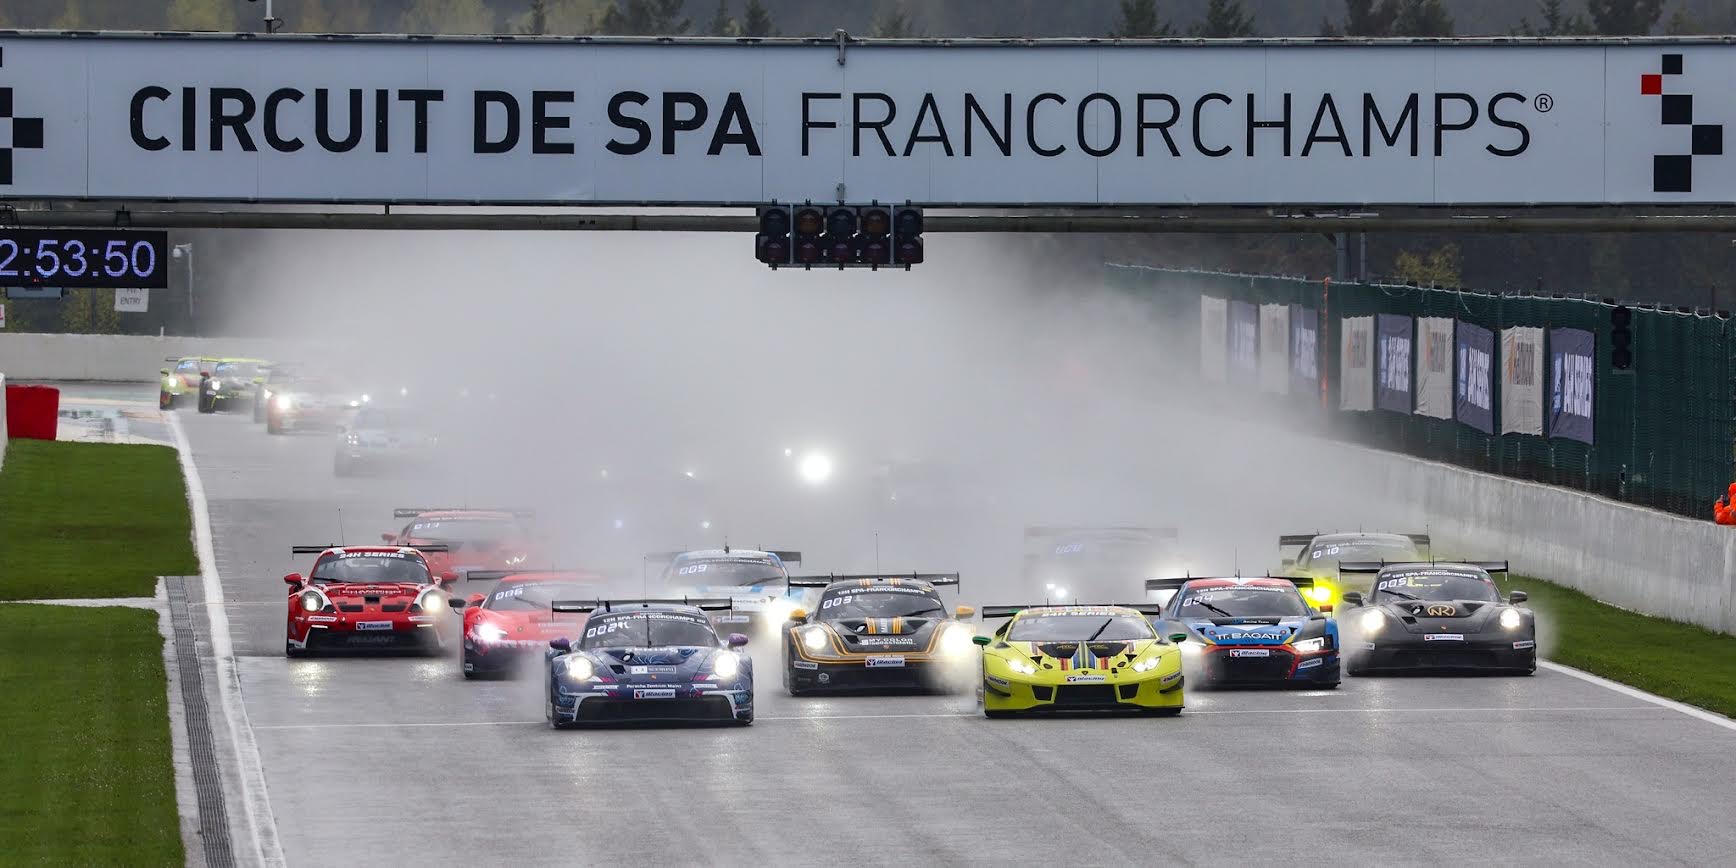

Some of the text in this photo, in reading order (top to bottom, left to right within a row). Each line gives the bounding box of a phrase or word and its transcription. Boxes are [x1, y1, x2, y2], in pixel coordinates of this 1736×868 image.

[129, 85, 444, 154] CIRCUIT
[473, 90, 575, 155] DE
[604, 90, 762, 157] SPA
[0, 239, 156, 277] 2:53:50
[120, 297, 141, 305] ENTRY
[363, 551, 405, 559] SERIES
[679, 564, 707, 575] 009
[822, 595, 853, 609] 003
